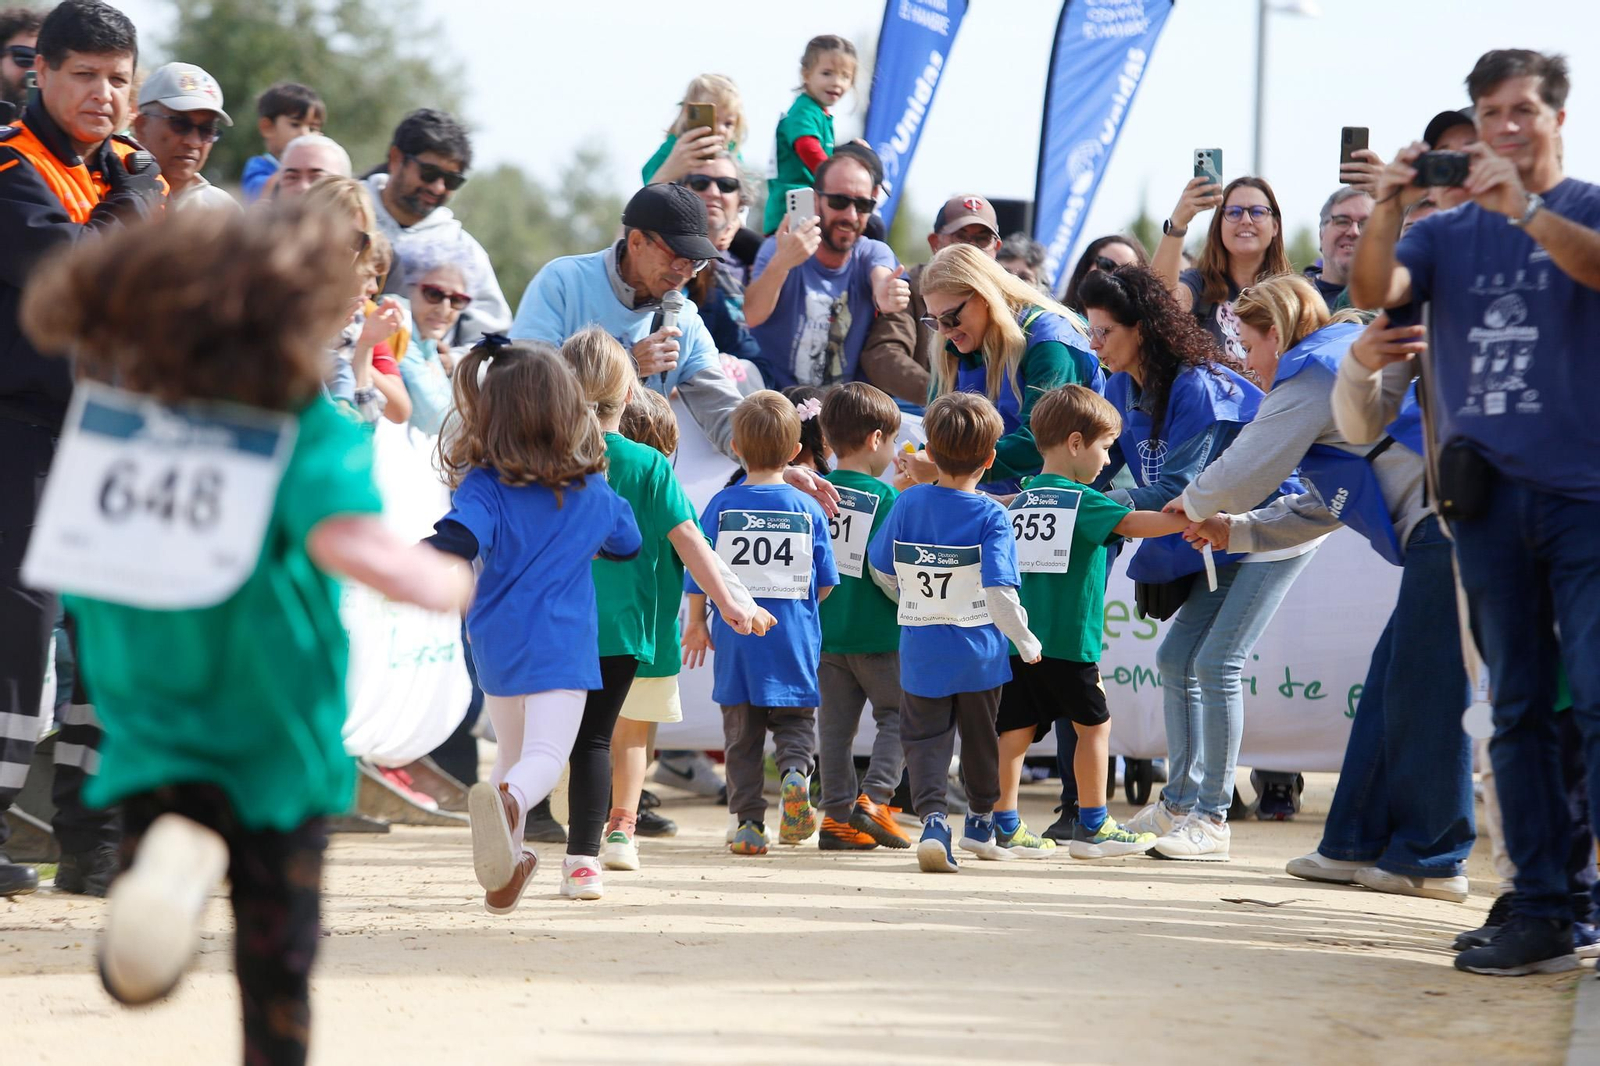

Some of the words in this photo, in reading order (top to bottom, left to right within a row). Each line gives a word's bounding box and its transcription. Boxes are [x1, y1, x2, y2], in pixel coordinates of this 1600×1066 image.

[97, 457, 226, 536] 648
[766, 522, 791, 530] Sevilla
[1012, 513, 1057, 541] 653
[730, 536, 794, 567] 204
[937, 557, 959, 565] Sevilla
[747, 585, 766, 593] ultura
[916, 571, 953, 600] 37
